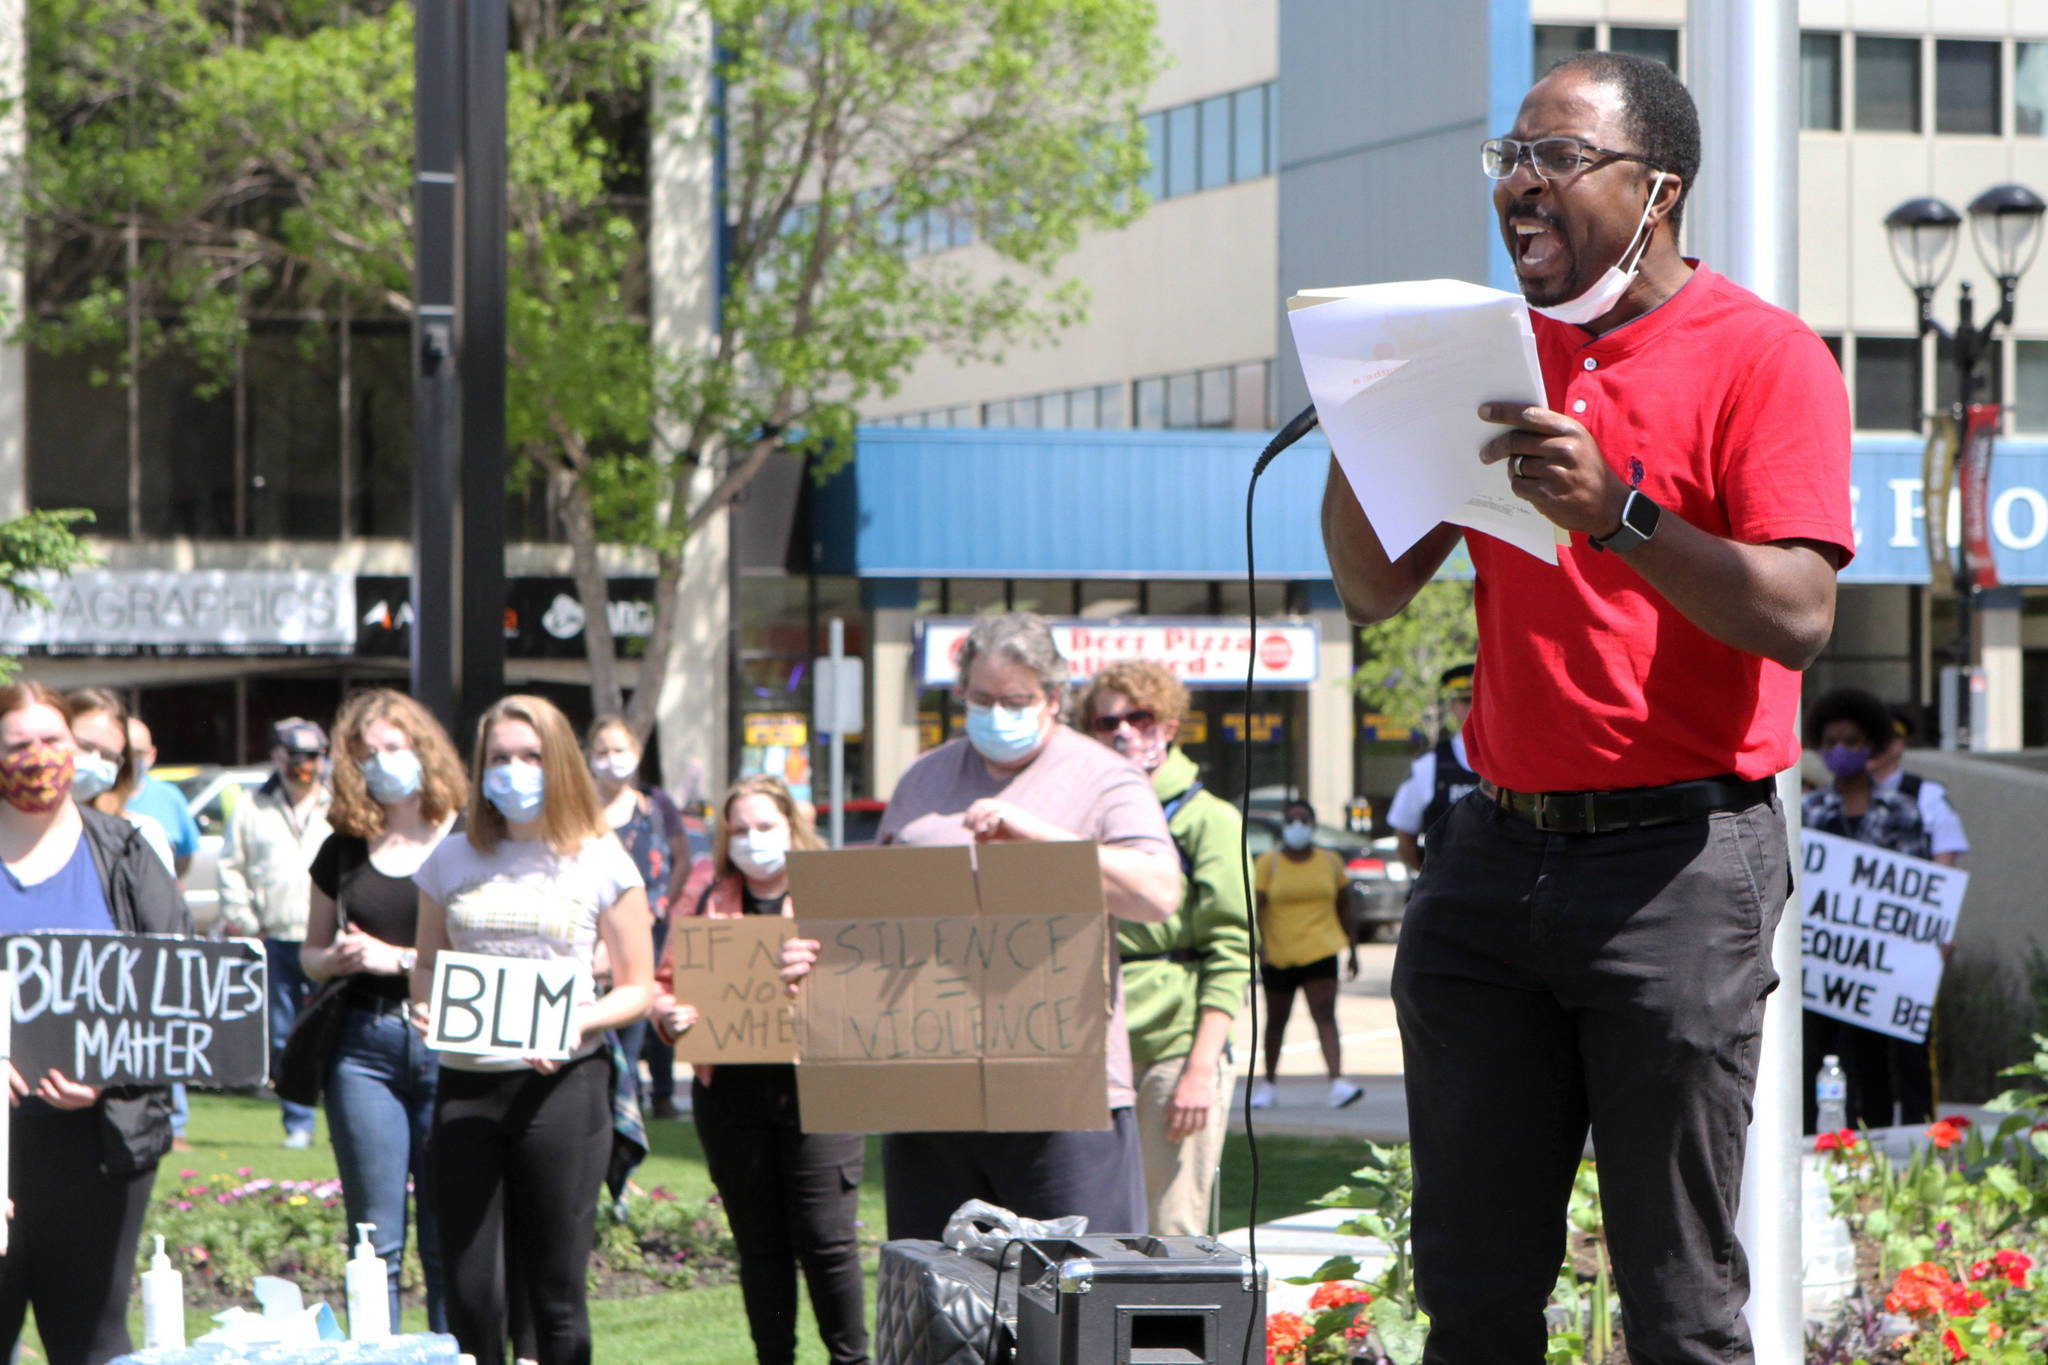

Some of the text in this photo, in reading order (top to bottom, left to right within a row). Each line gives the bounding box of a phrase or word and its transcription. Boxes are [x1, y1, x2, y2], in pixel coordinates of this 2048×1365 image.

[1851, 854, 1947, 908] MADE
[680, 926, 733, 973] IF
[834, 914, 1071, 975] SILENCE
[7, 936, 265, 1024] BLACK LIVES
[436, 963, 576, 1052] BLM
[850, 996, 1077, 1059] VIOLENCE
[1891, 994, 1932, 1036] BE
[75, 1017, 213, 1081] MATTER
